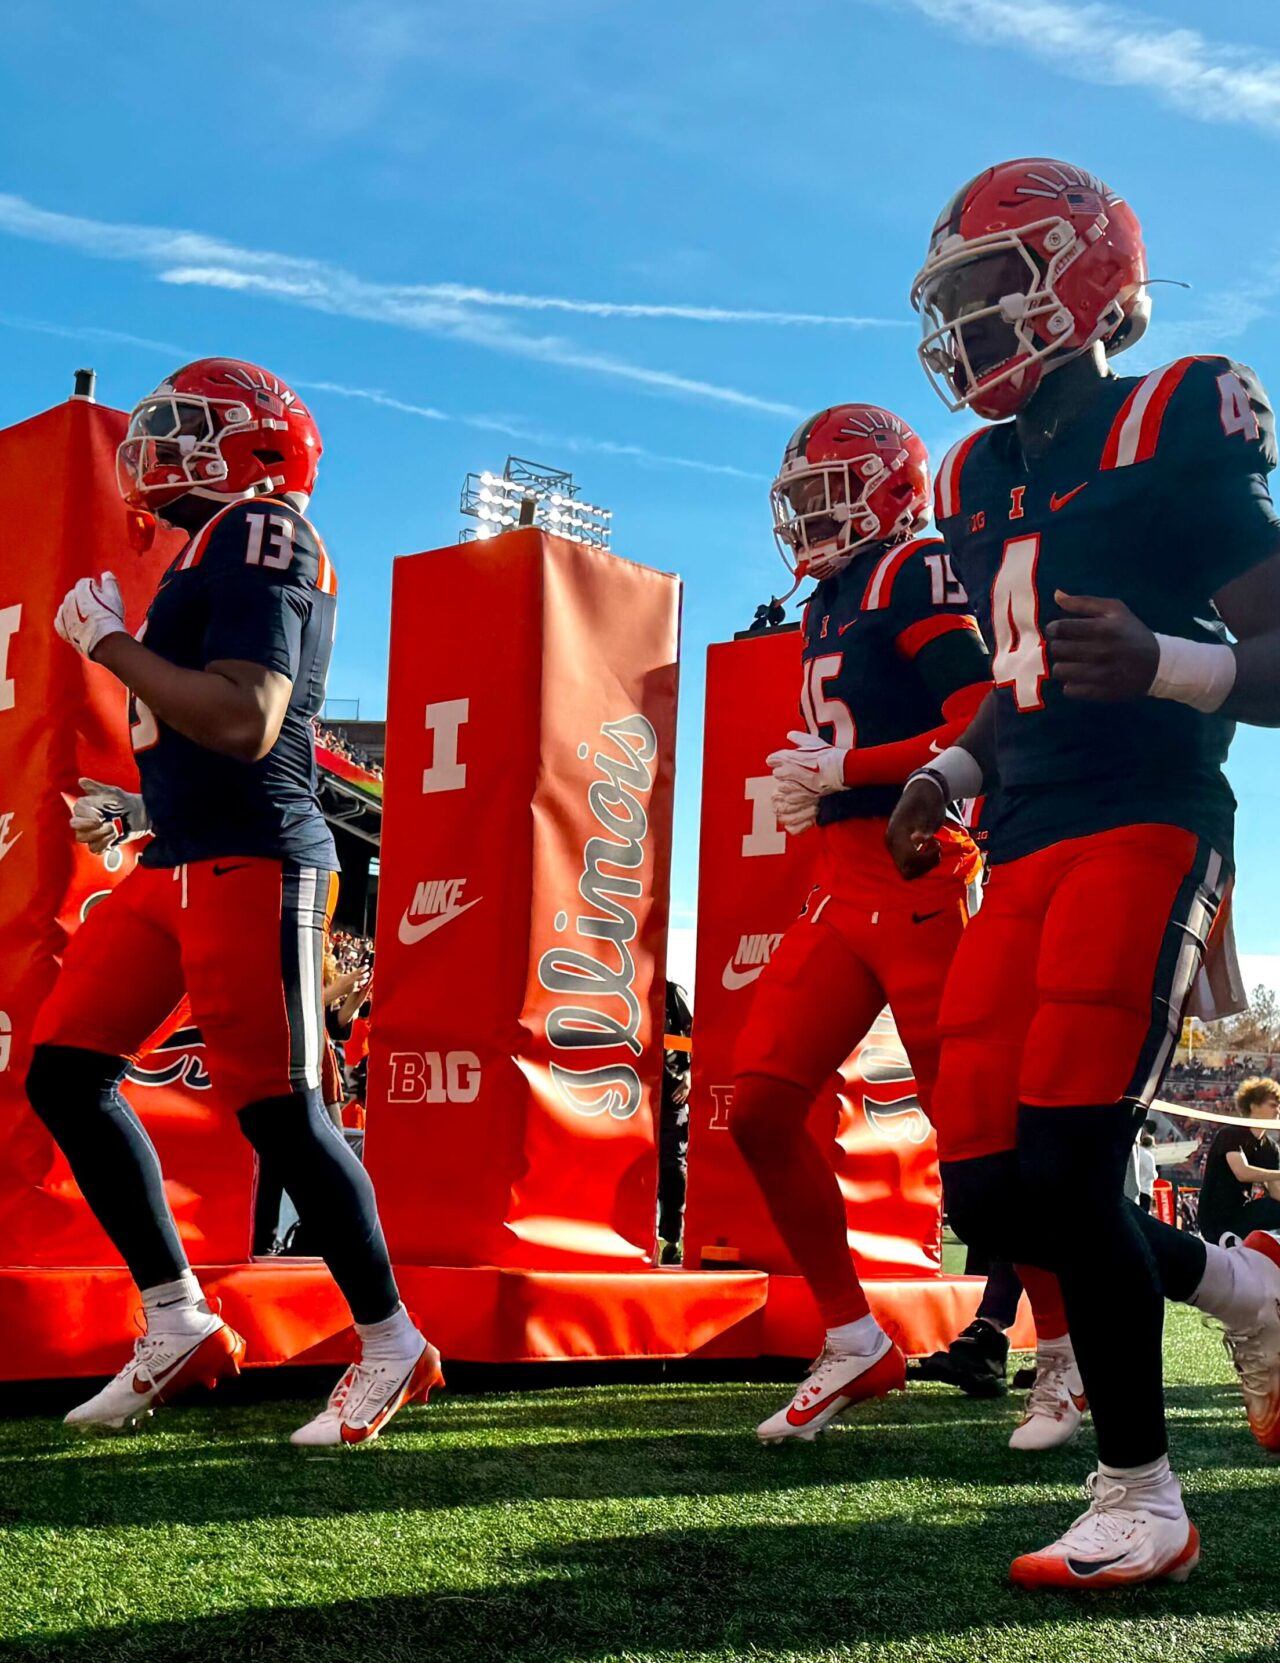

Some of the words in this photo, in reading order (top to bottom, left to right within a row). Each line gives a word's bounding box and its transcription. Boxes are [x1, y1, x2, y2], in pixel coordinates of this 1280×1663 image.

[1215, 370, 1261, 441] 4
[1008, 485, 1027, 520] I
[245, 512, 296, 570] 13
[992, 532, 1050, 714] 4
[422, 698, 470, 794] I
[742, 775, 786, 857] I
[409, 878, 467, 916] NIKE
[538, 712, 657, 1121] Illinois
[388, 1050, 482, 1104] B1G
